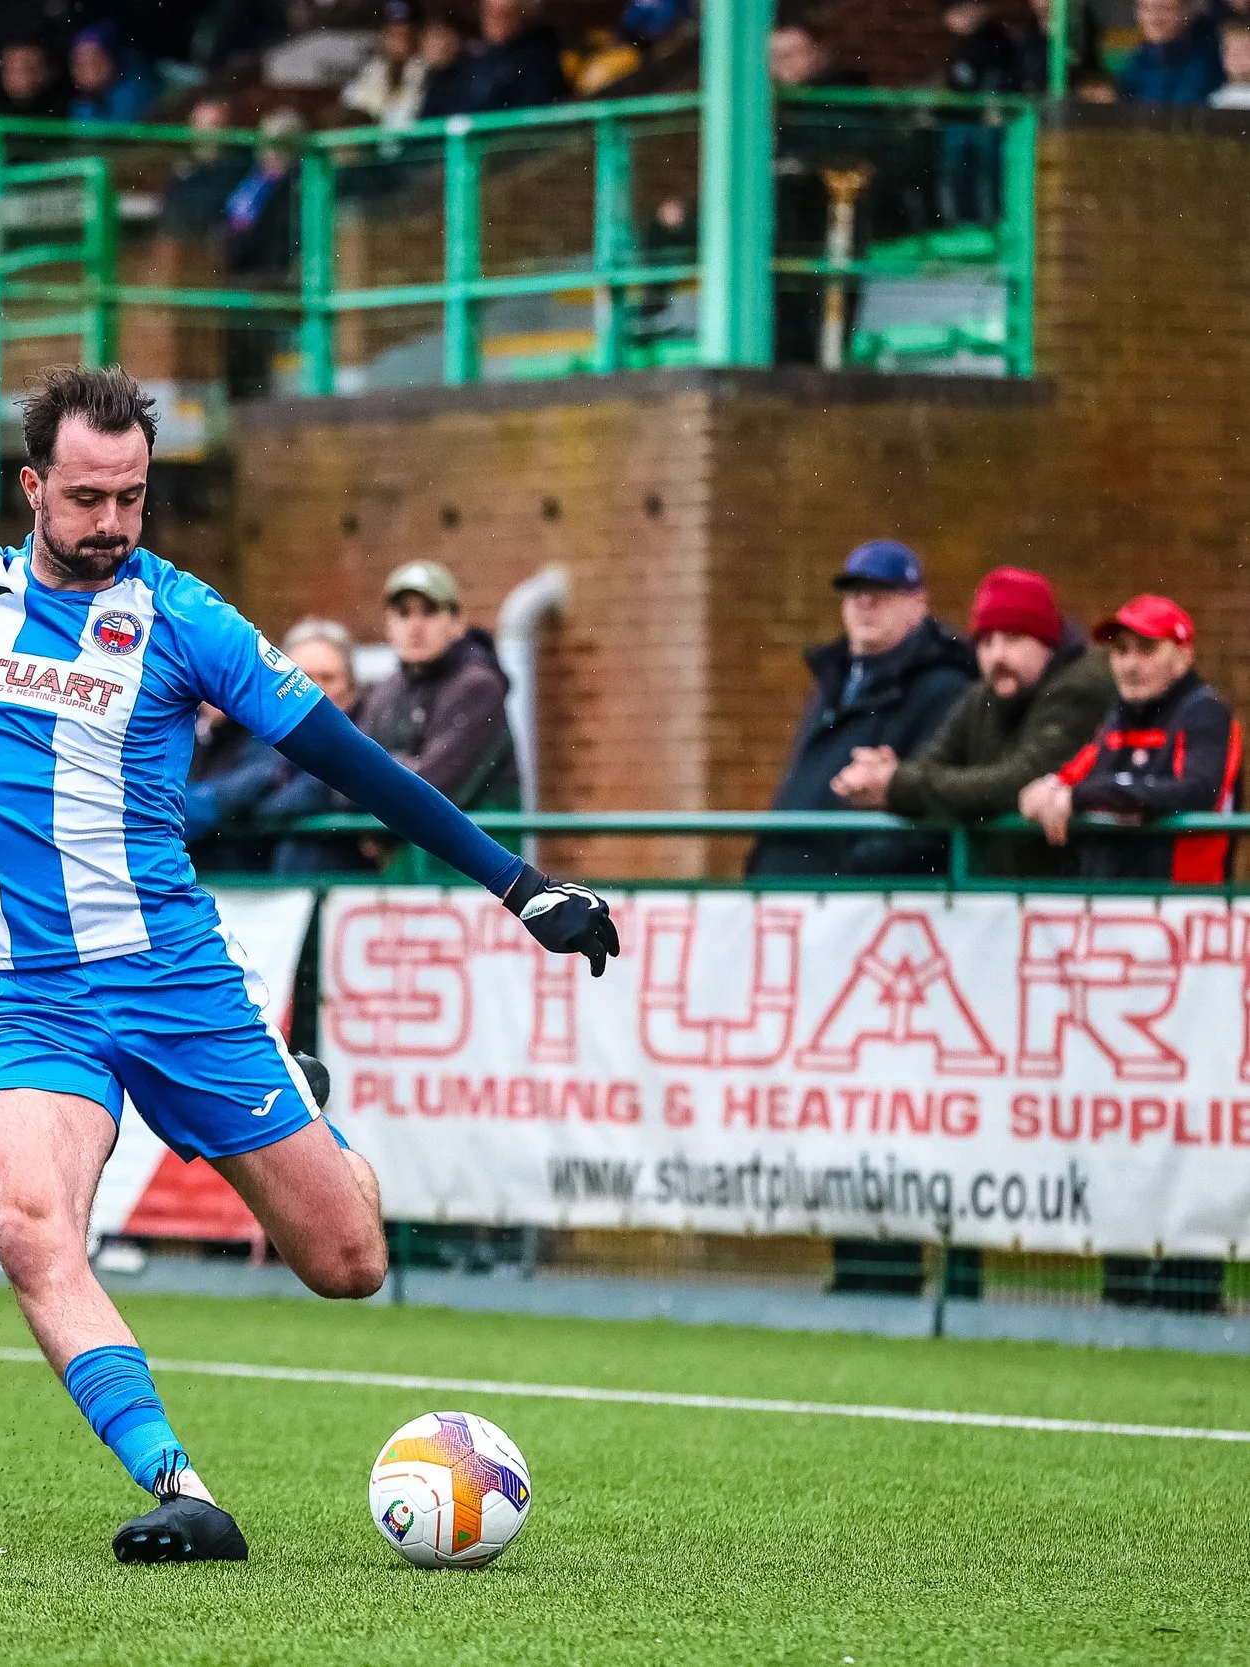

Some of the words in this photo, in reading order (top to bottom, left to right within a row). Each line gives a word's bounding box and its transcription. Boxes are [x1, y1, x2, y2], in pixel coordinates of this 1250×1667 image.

[16, 687, 56, 702] HEATING
[59, 696, 106, 716] SUPPLIES
[293, 689, 303, 698] &
[351, 1072, 643, 1126] PLUMBING
[664, 1081, 694, 1127] &
[723, 1084, 978, 1138] HEATING
[549, 1151, 1091, 1229] www.stuartplumbing.co.uk
